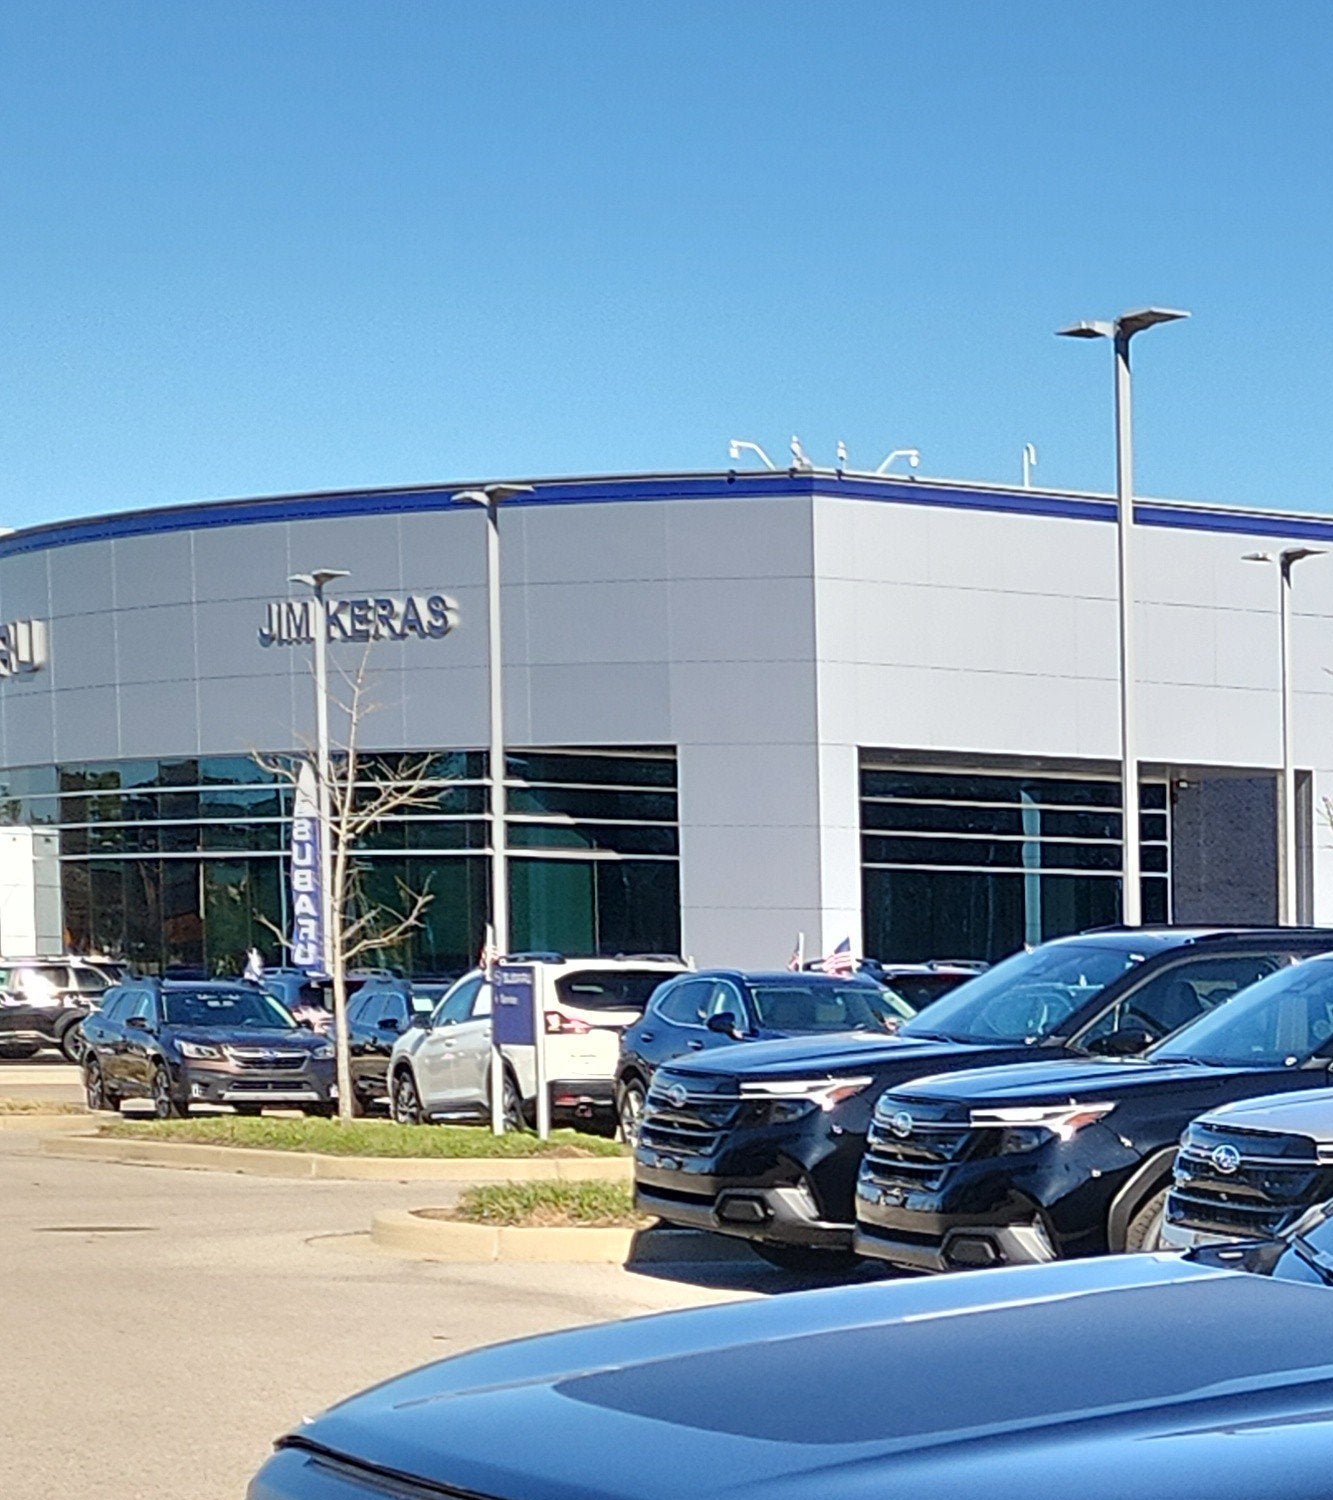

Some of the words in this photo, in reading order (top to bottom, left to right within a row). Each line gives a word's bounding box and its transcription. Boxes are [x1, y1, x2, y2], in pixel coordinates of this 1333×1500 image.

[258, 601, 316, 648] JIM
[325, 595, 459, 643] KERAS
[292, 816, 321, 966] SUBARU
